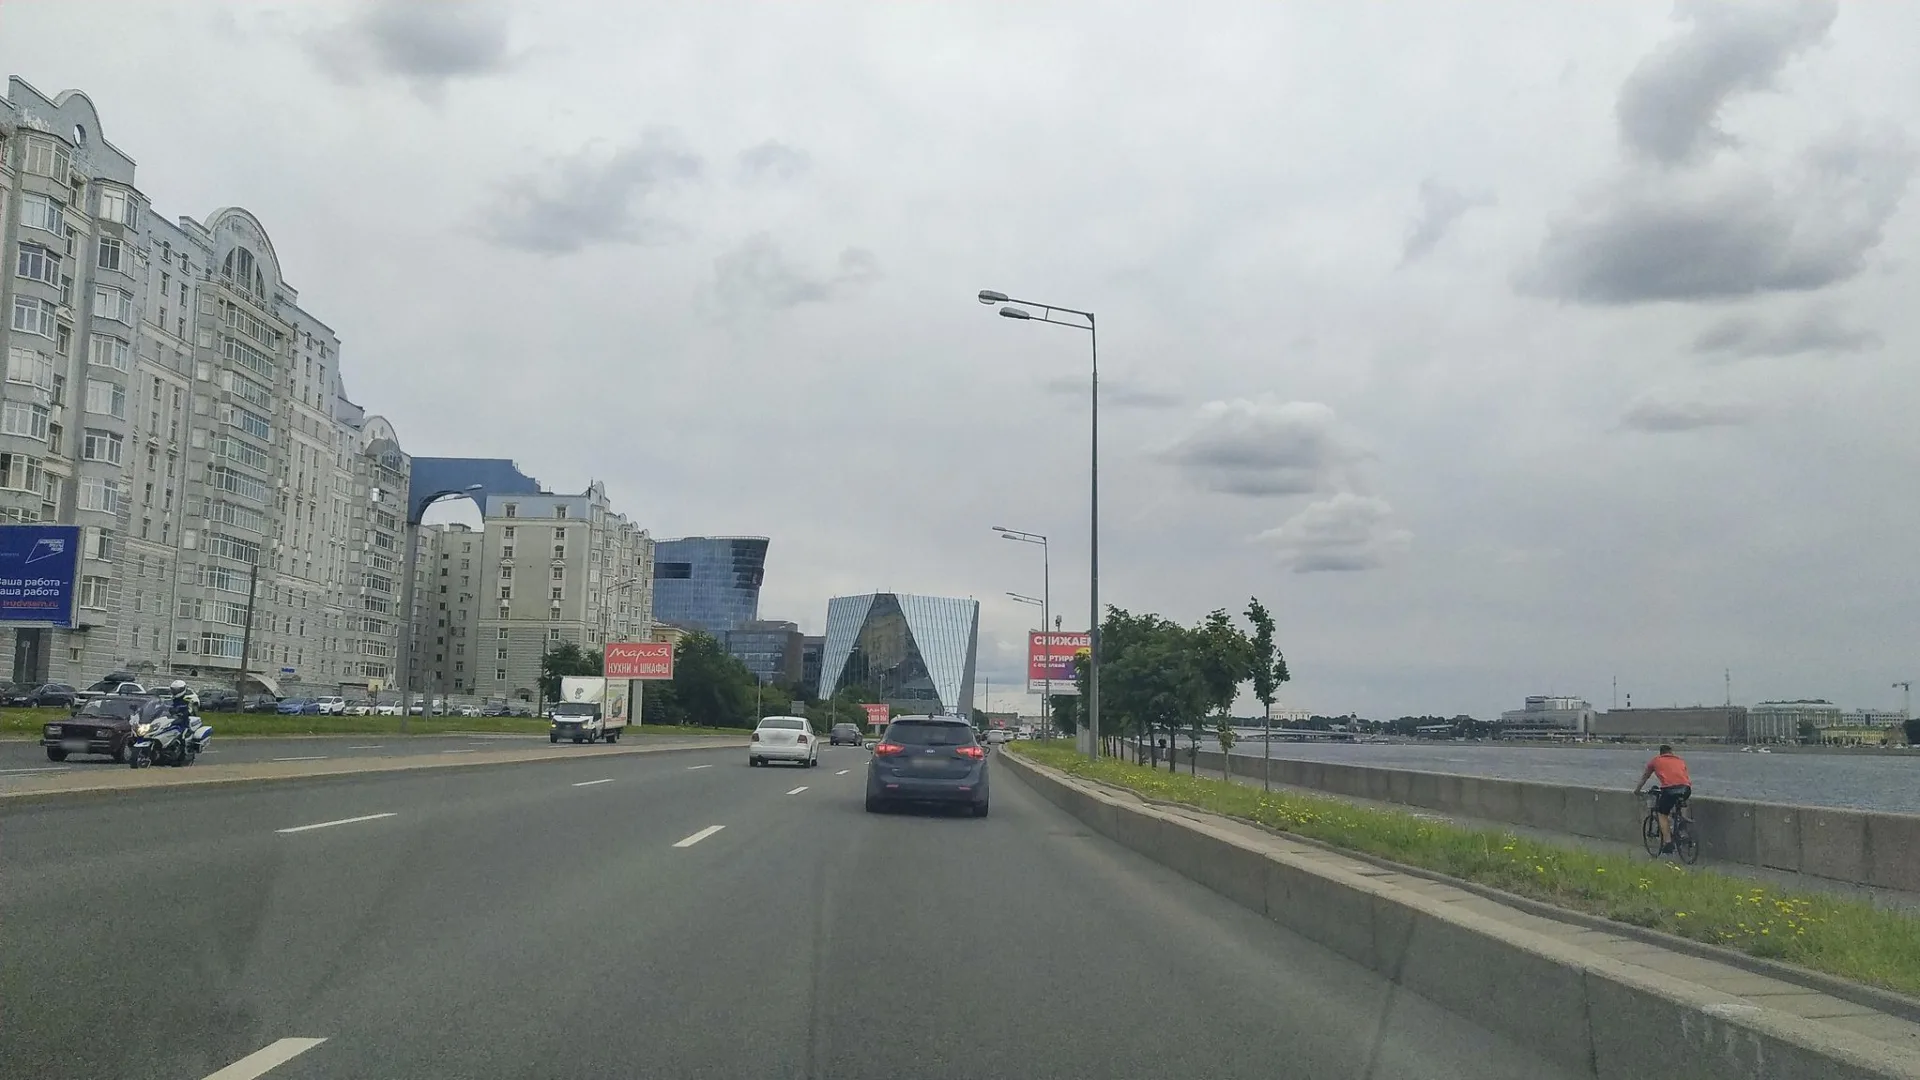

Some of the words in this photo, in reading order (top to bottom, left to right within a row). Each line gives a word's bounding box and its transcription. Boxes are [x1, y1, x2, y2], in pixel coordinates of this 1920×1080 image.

[24, 577, 60, 587] работа
[23, 587, 60, 597] работа
[608, 662, 632, 673] КУХНИ
[640, 662, 669, 673] ШКАФЫ
